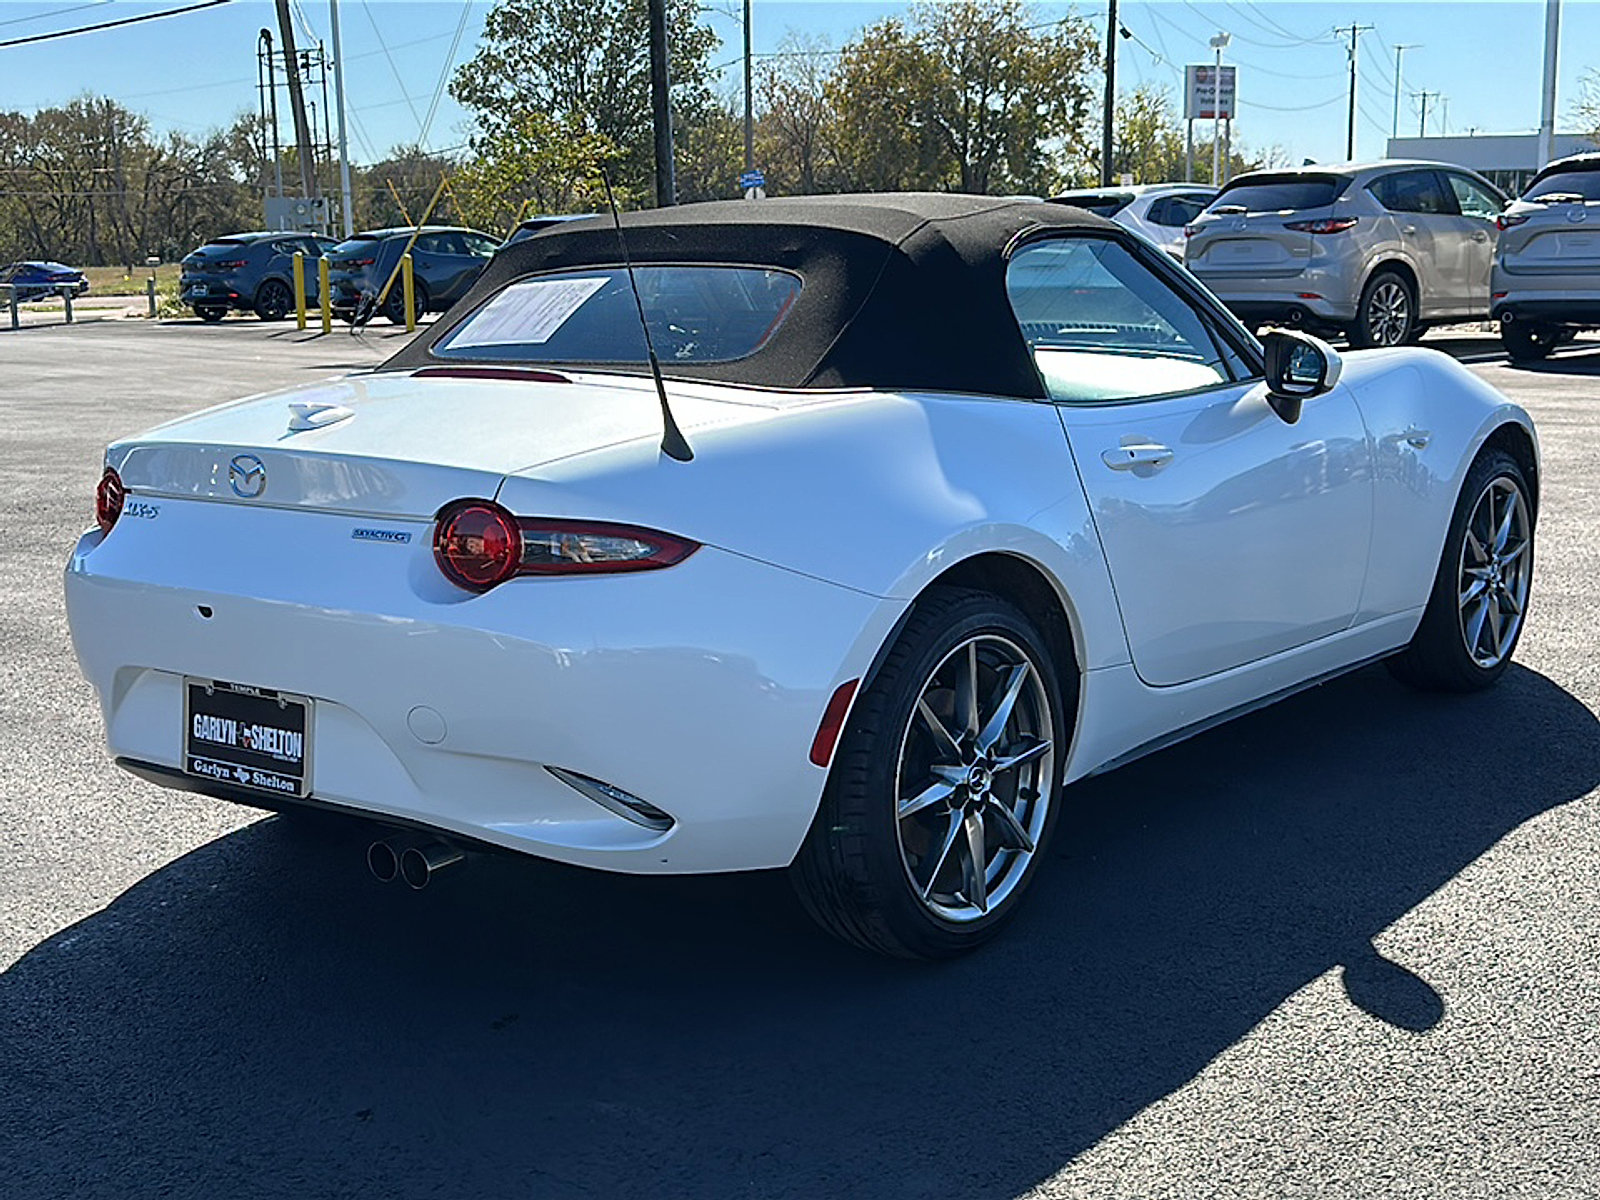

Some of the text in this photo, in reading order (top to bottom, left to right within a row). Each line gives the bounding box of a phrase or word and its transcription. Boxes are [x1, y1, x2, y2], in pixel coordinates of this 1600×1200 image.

[193, 713, 302, 758] GARLYN SHELTON
[193, 759, 295, 792] Garlyn Shelton
